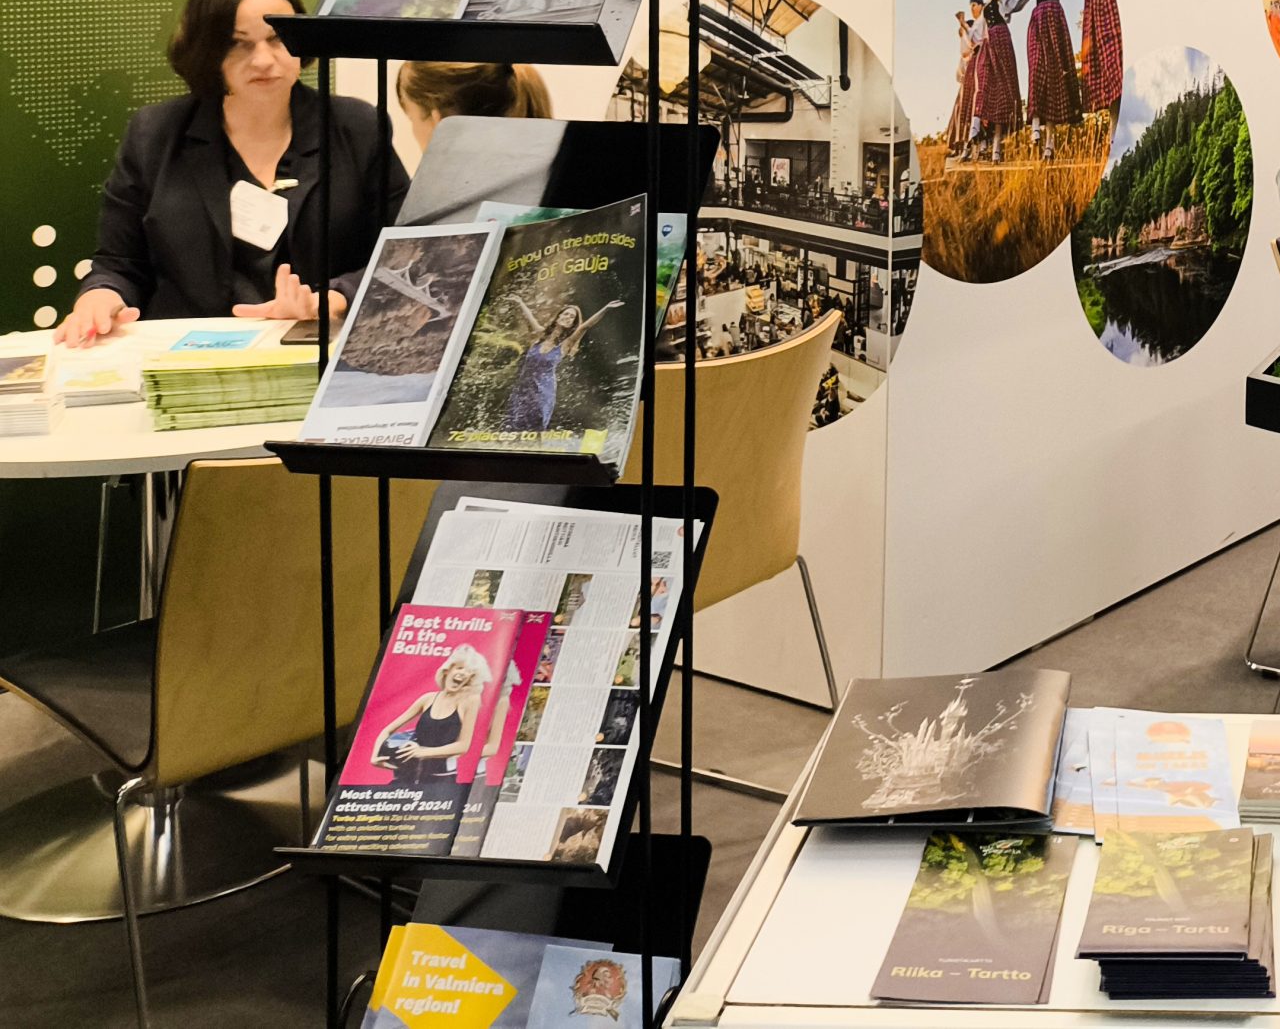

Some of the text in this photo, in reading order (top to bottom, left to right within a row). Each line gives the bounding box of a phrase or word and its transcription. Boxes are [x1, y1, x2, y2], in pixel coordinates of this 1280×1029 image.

[506, 232, 637, 272] Enjoy on the both sides
[562, 255, 609, 275] Gauja
[447, 429, 573, 443] 72 places to visit
[402, 614, 493, 633] Best thrills
[396, 627, 446, 643] in the
[392, 641, 452, 657] Baltics
[340, 788, 424, 801] Most exciting
[335, 800, 453, 812] attraction of 2024!
[1172, 924, 1230, 934] Tartu
[411, 950, 467, 969] Travel
[890, 966, 943, 979] Riika
[967, 967, 1032, 980] Tartto
[402, 971, 504, 996] in Valmiera
[395, 998, 461, 1015] region!
